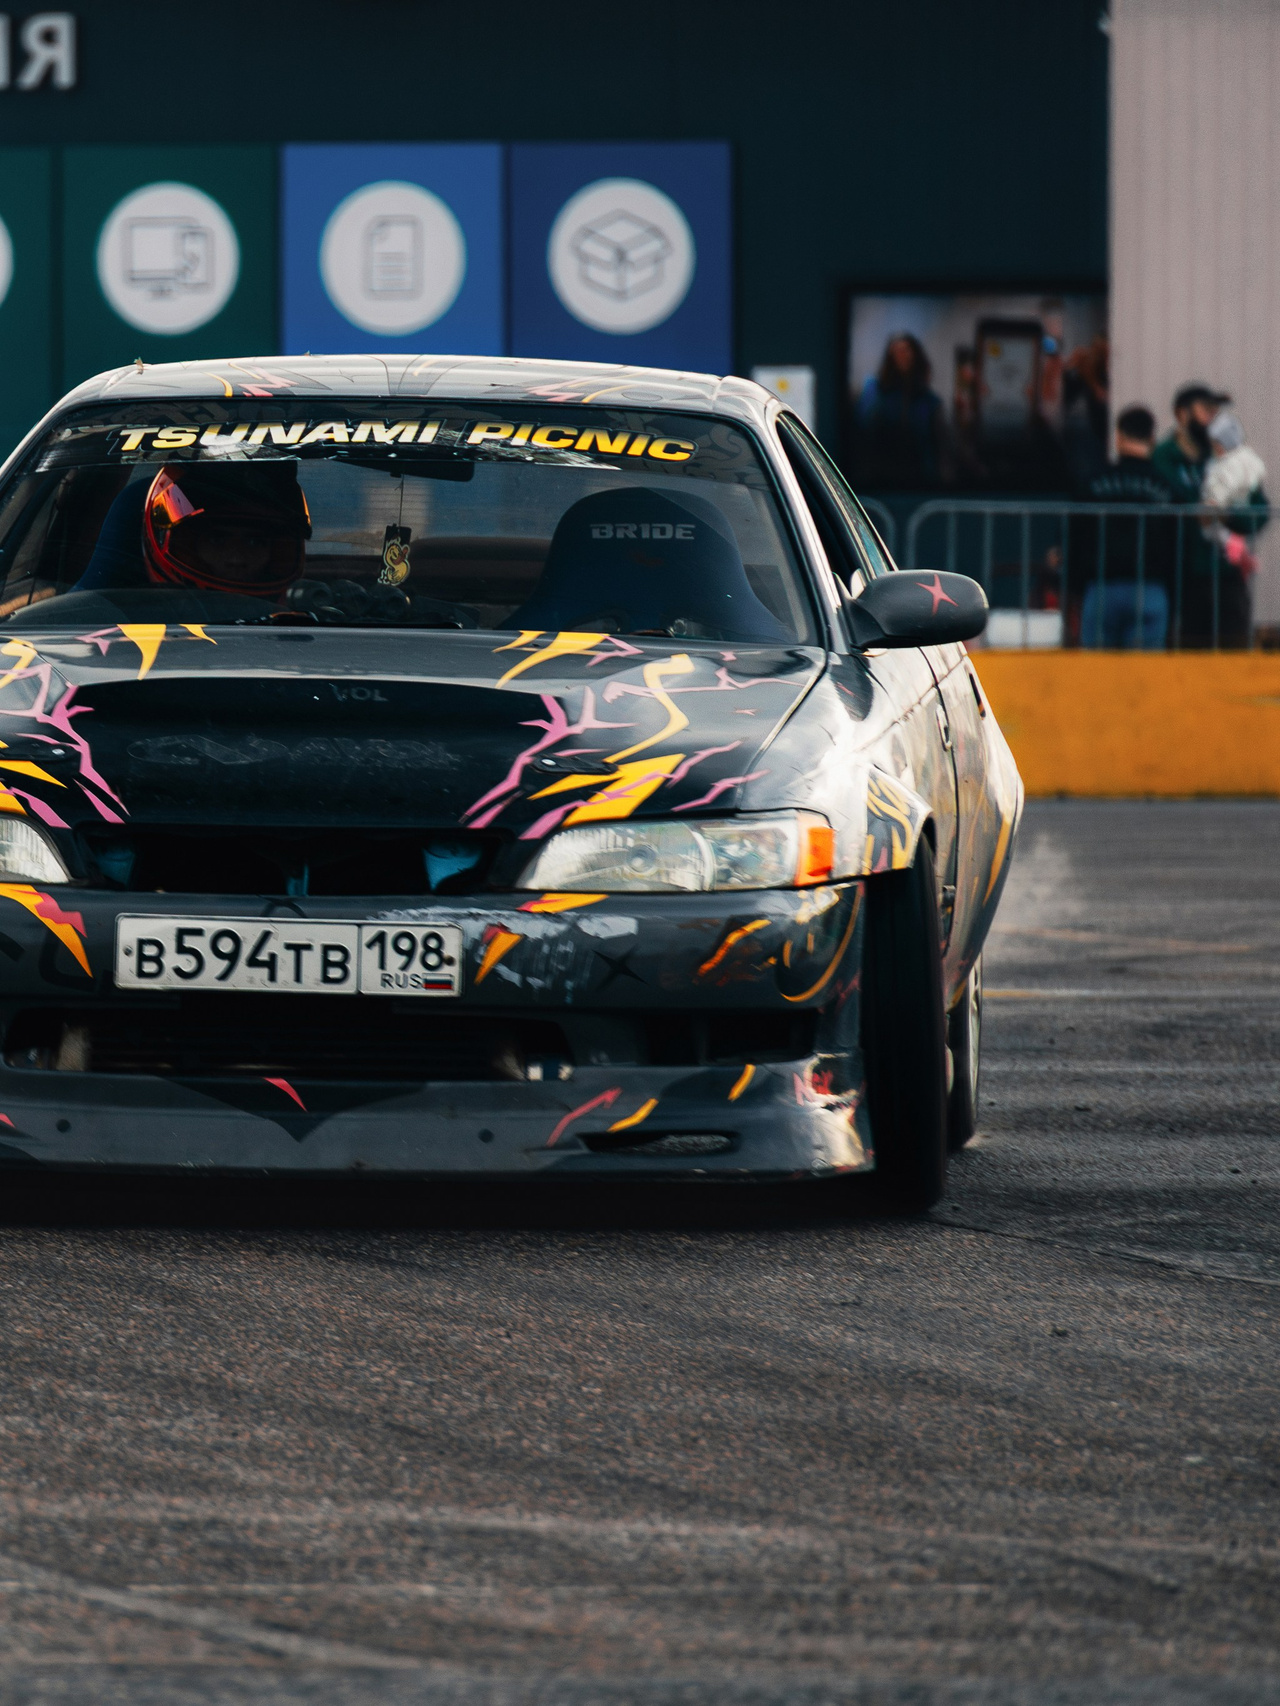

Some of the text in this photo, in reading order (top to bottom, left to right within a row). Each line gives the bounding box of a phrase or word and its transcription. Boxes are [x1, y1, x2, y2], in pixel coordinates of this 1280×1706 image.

[120, 419, 697, 462] TSUNAMI PICNIC
[589, 523, 696, 540] BRIDE
[365, 930, 446, 972] 198
[380, 973, 423, 990] RUS
